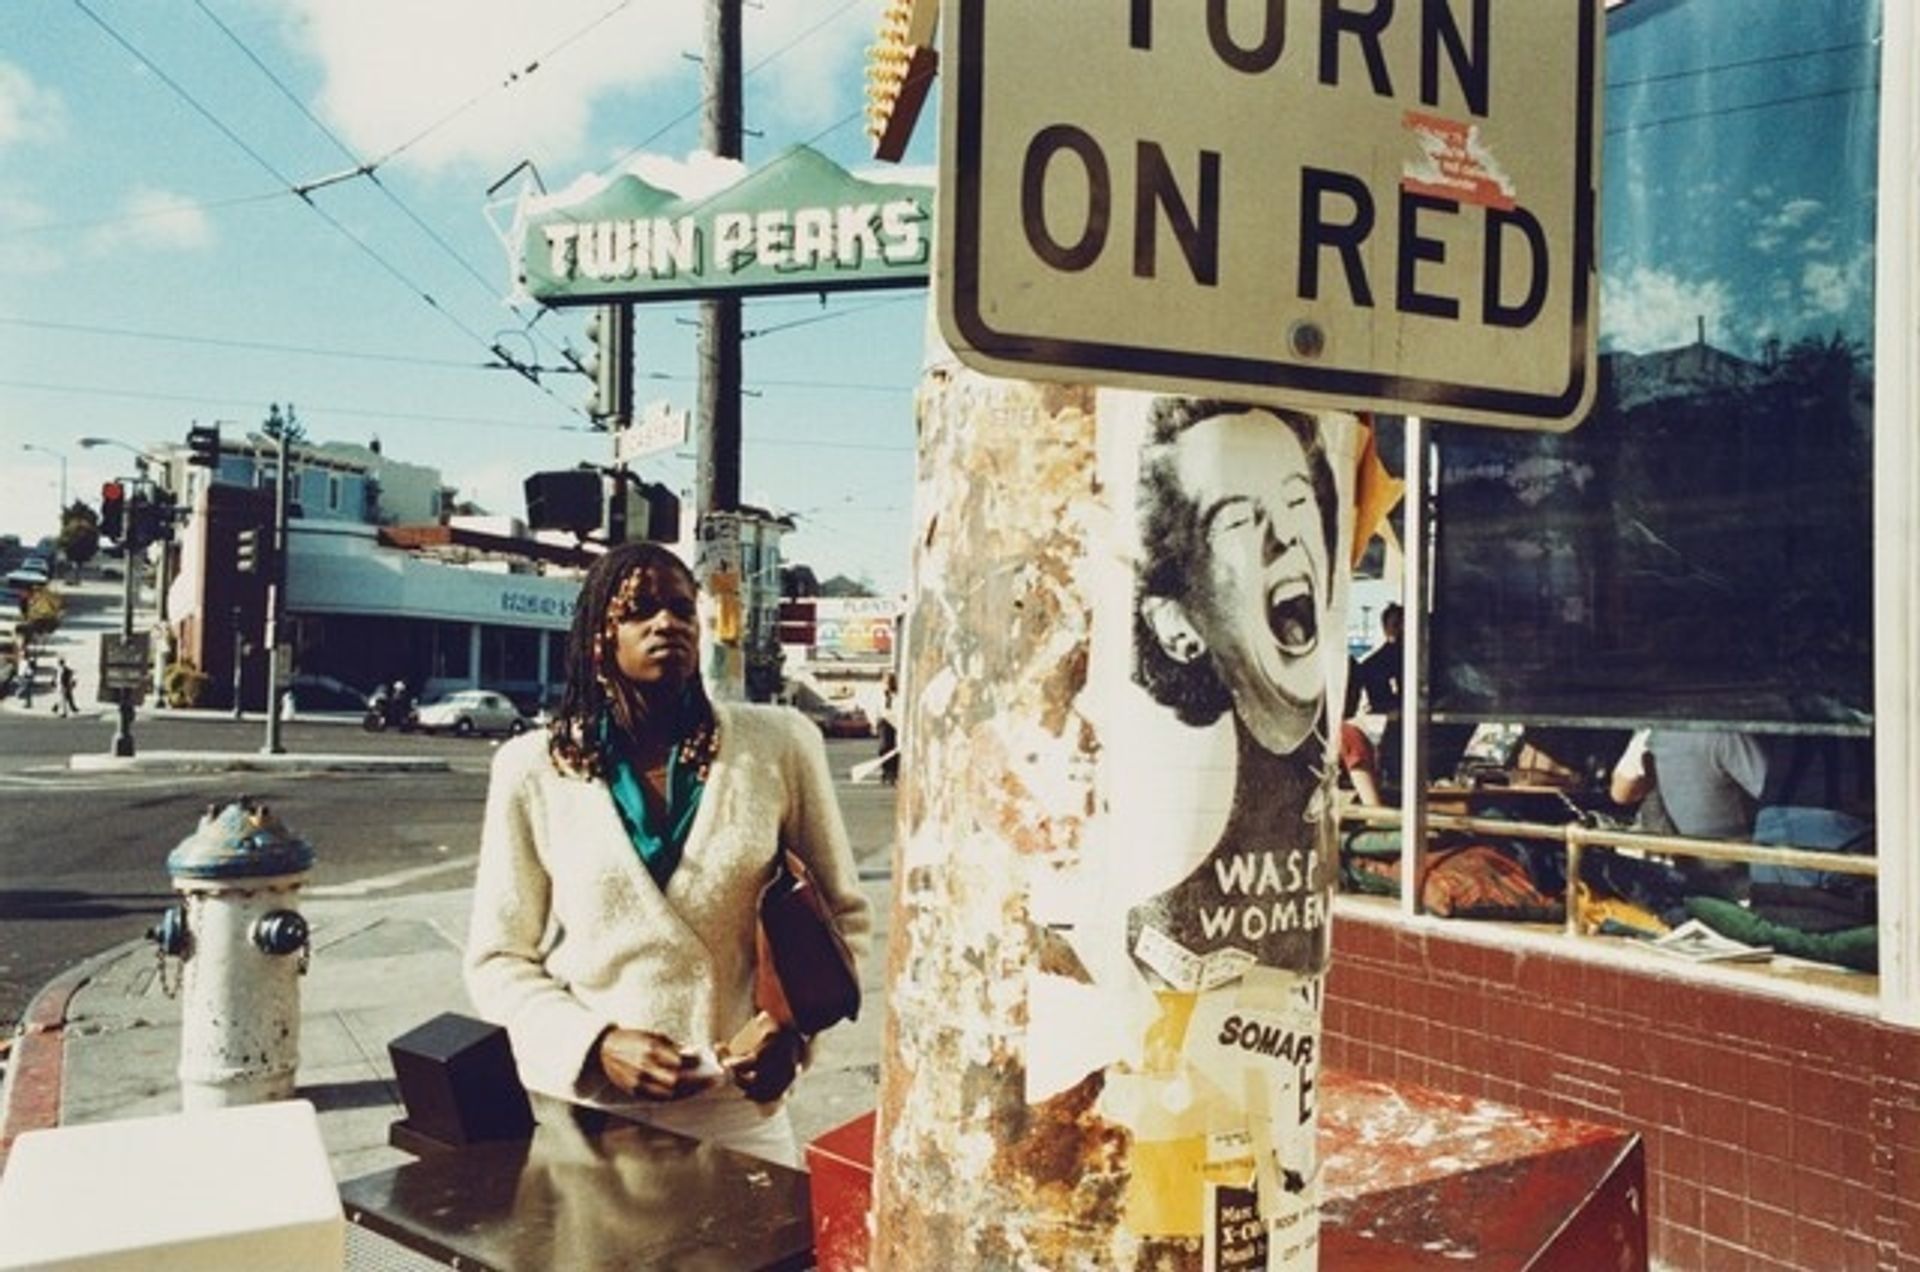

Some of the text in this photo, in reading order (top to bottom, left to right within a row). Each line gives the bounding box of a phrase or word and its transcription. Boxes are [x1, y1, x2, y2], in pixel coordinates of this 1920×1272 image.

[544, 200, 926, 281] TWIN PEAKS
[1020, 123, 1550, 328] ON RED
[1198, 892, 1325, 941] WOMEN
